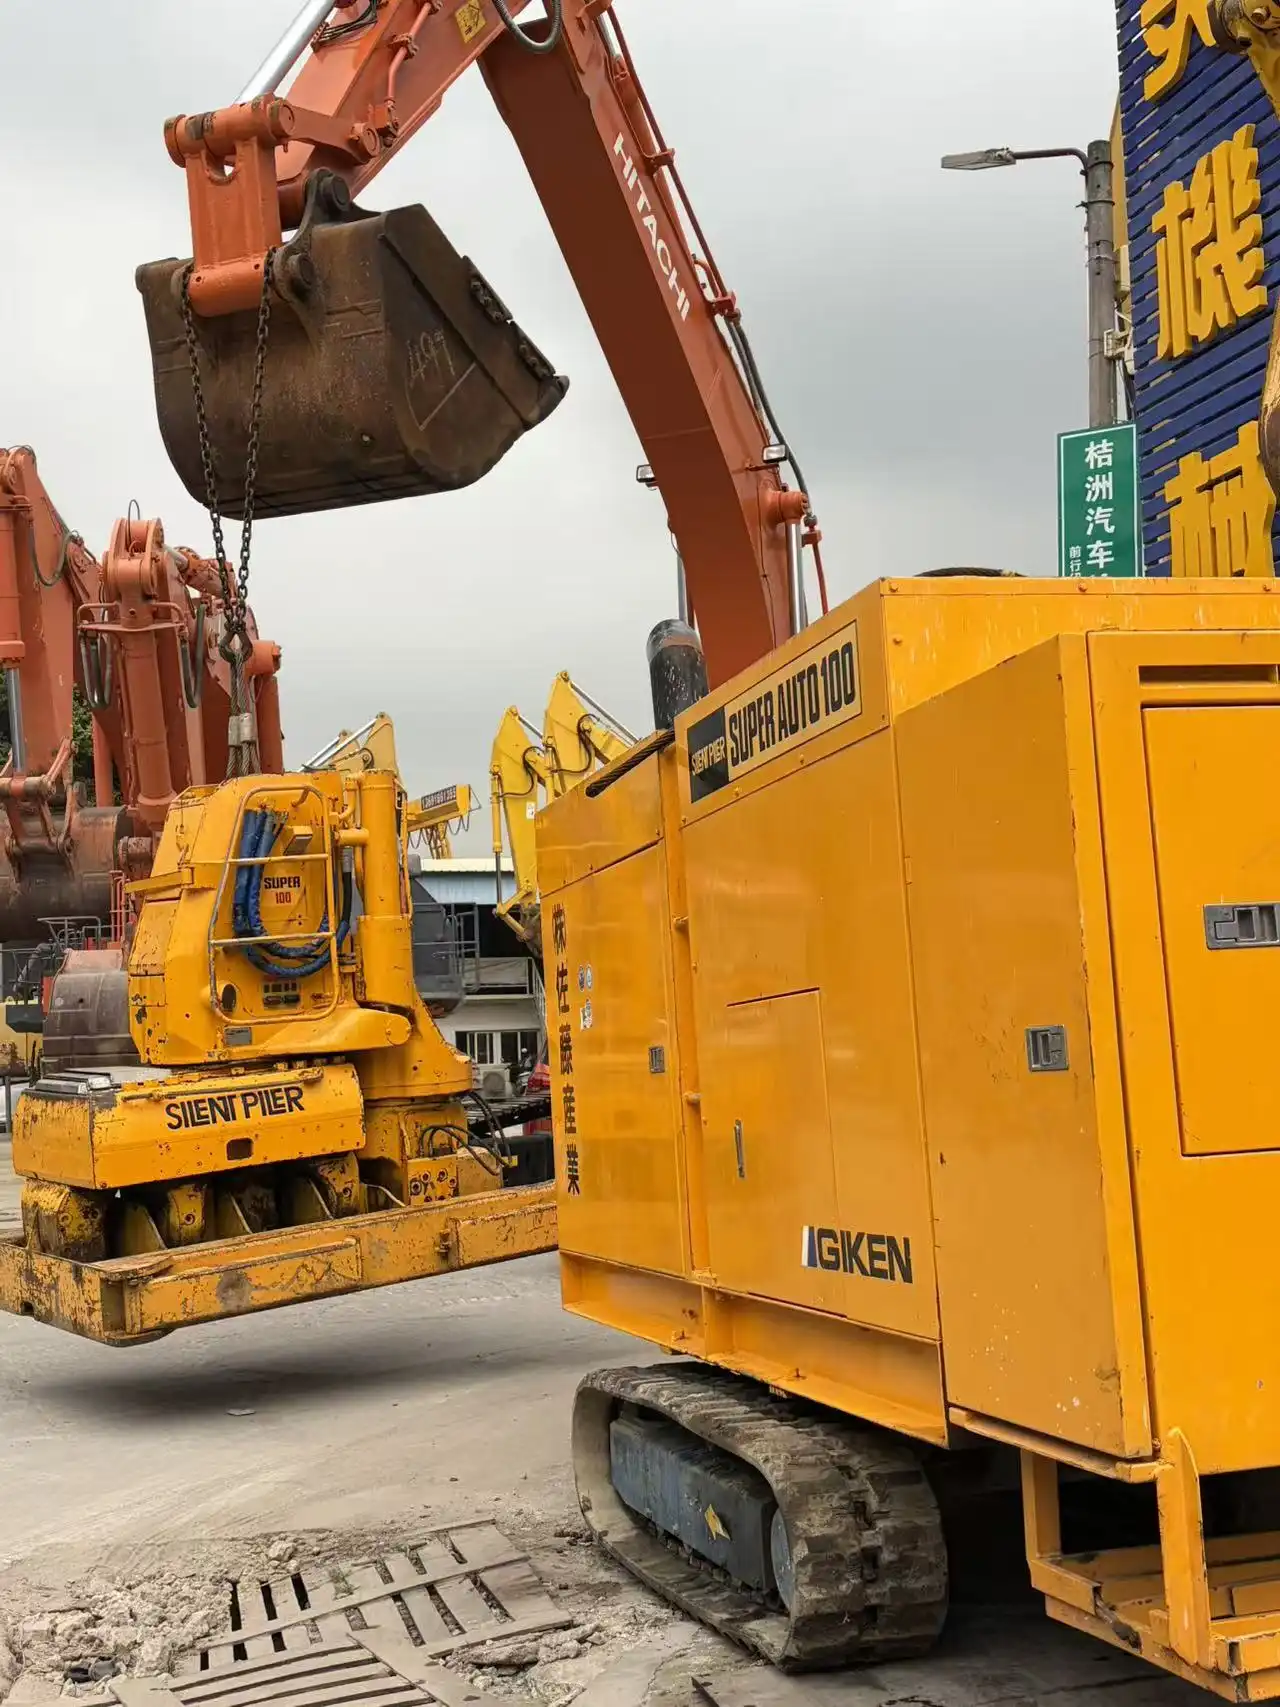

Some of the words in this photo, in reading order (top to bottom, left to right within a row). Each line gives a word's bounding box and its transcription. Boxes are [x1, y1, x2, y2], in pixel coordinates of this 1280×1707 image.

[613, 131, 690, 321] HITACHI
[1085, 438, 1115, 577] 桔洲汽车
[729, 690, 776, 767] SUPER
[777, 663, 820, 742] AUTO
[820, 641, 856, 717] 100
[264, 876, 300, 889] SUPER
[275, 892, 291, 904] 100
[165, 1094, 237, 1130] SILENT
[241, 1086, 305, 1119] PILER
